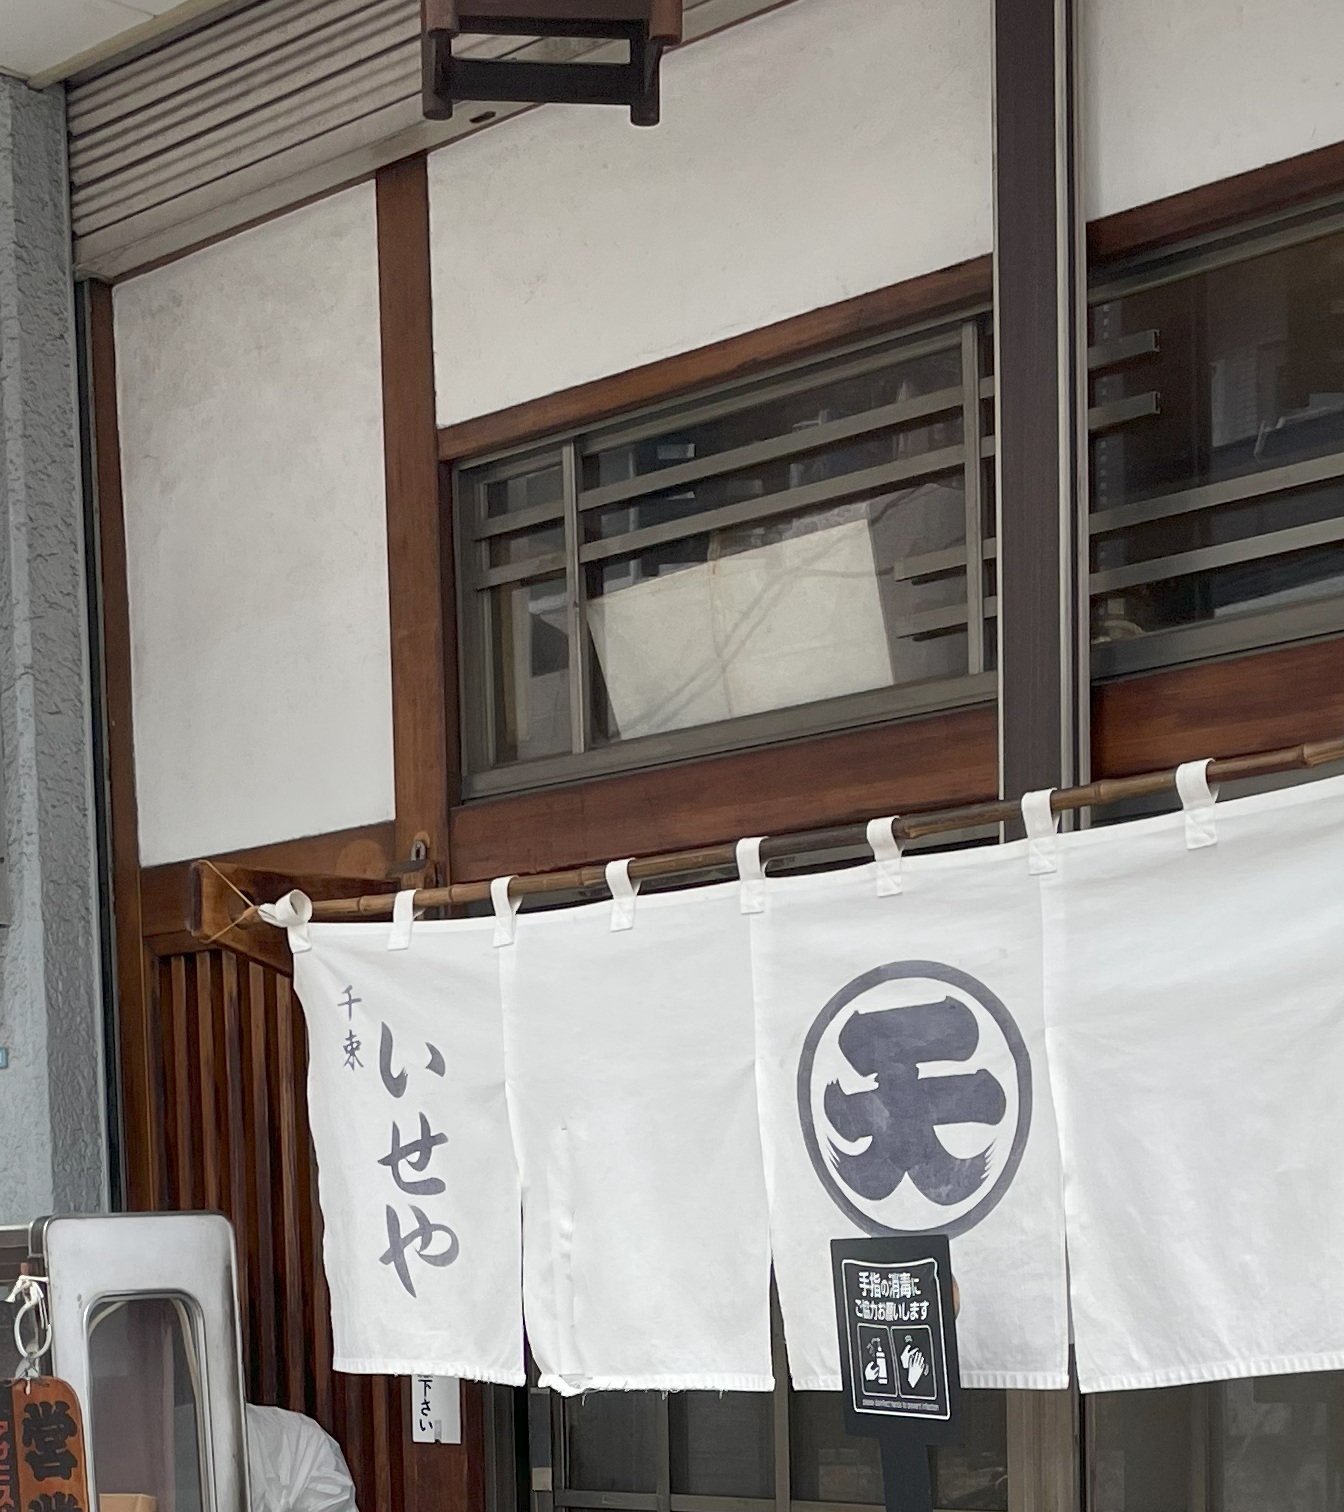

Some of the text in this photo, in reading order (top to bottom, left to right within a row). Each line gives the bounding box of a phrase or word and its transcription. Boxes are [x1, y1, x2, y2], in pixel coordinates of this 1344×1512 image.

[337, 985, 363, 1070] 千束
[823, 995, 1007, 1207] 天
[377, 1022, 459, 1298] いせや
[855, 1299, 930, 1322] ご協力お願いします
[859, 1271, 922, 1299] 手指の消毒に
[418, 1374, 433, 1432] 下さい
